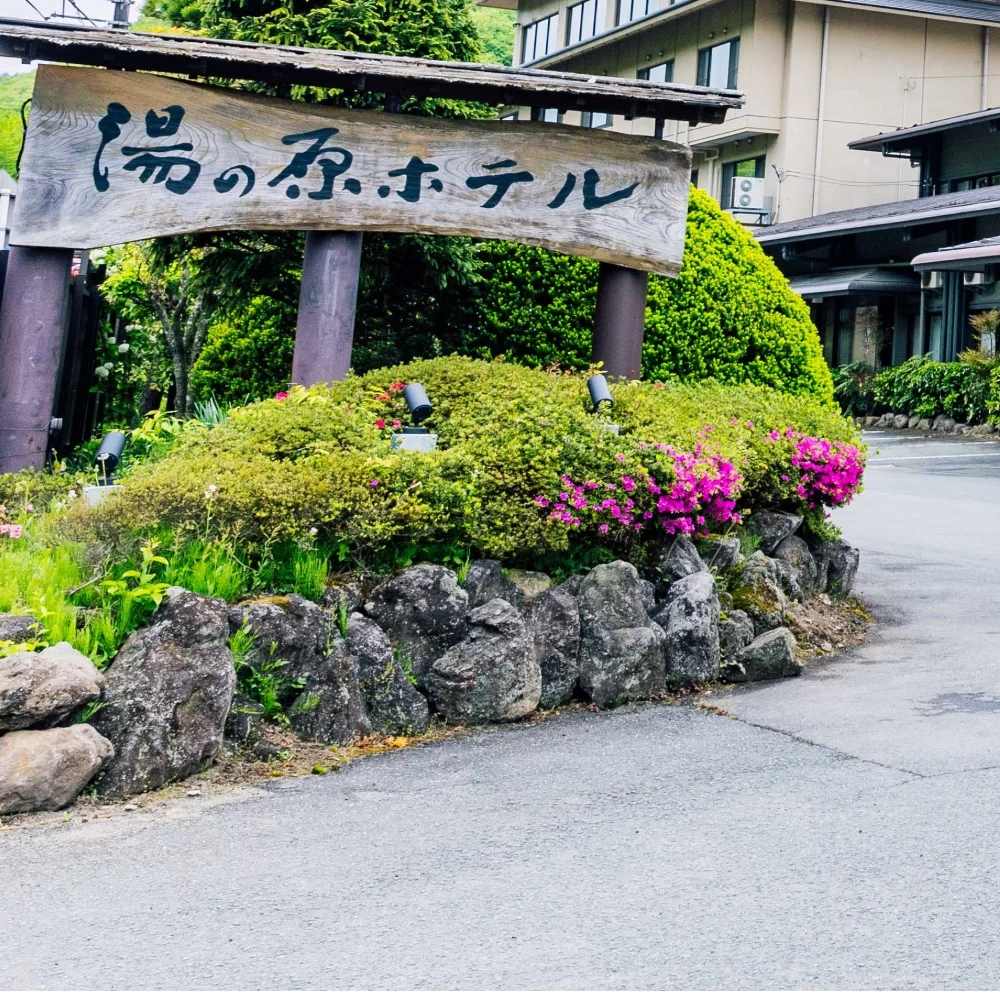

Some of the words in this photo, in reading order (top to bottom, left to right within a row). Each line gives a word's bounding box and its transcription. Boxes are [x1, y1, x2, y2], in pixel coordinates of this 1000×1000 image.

[93, 102, 639, 210] 湯の原ホテル
